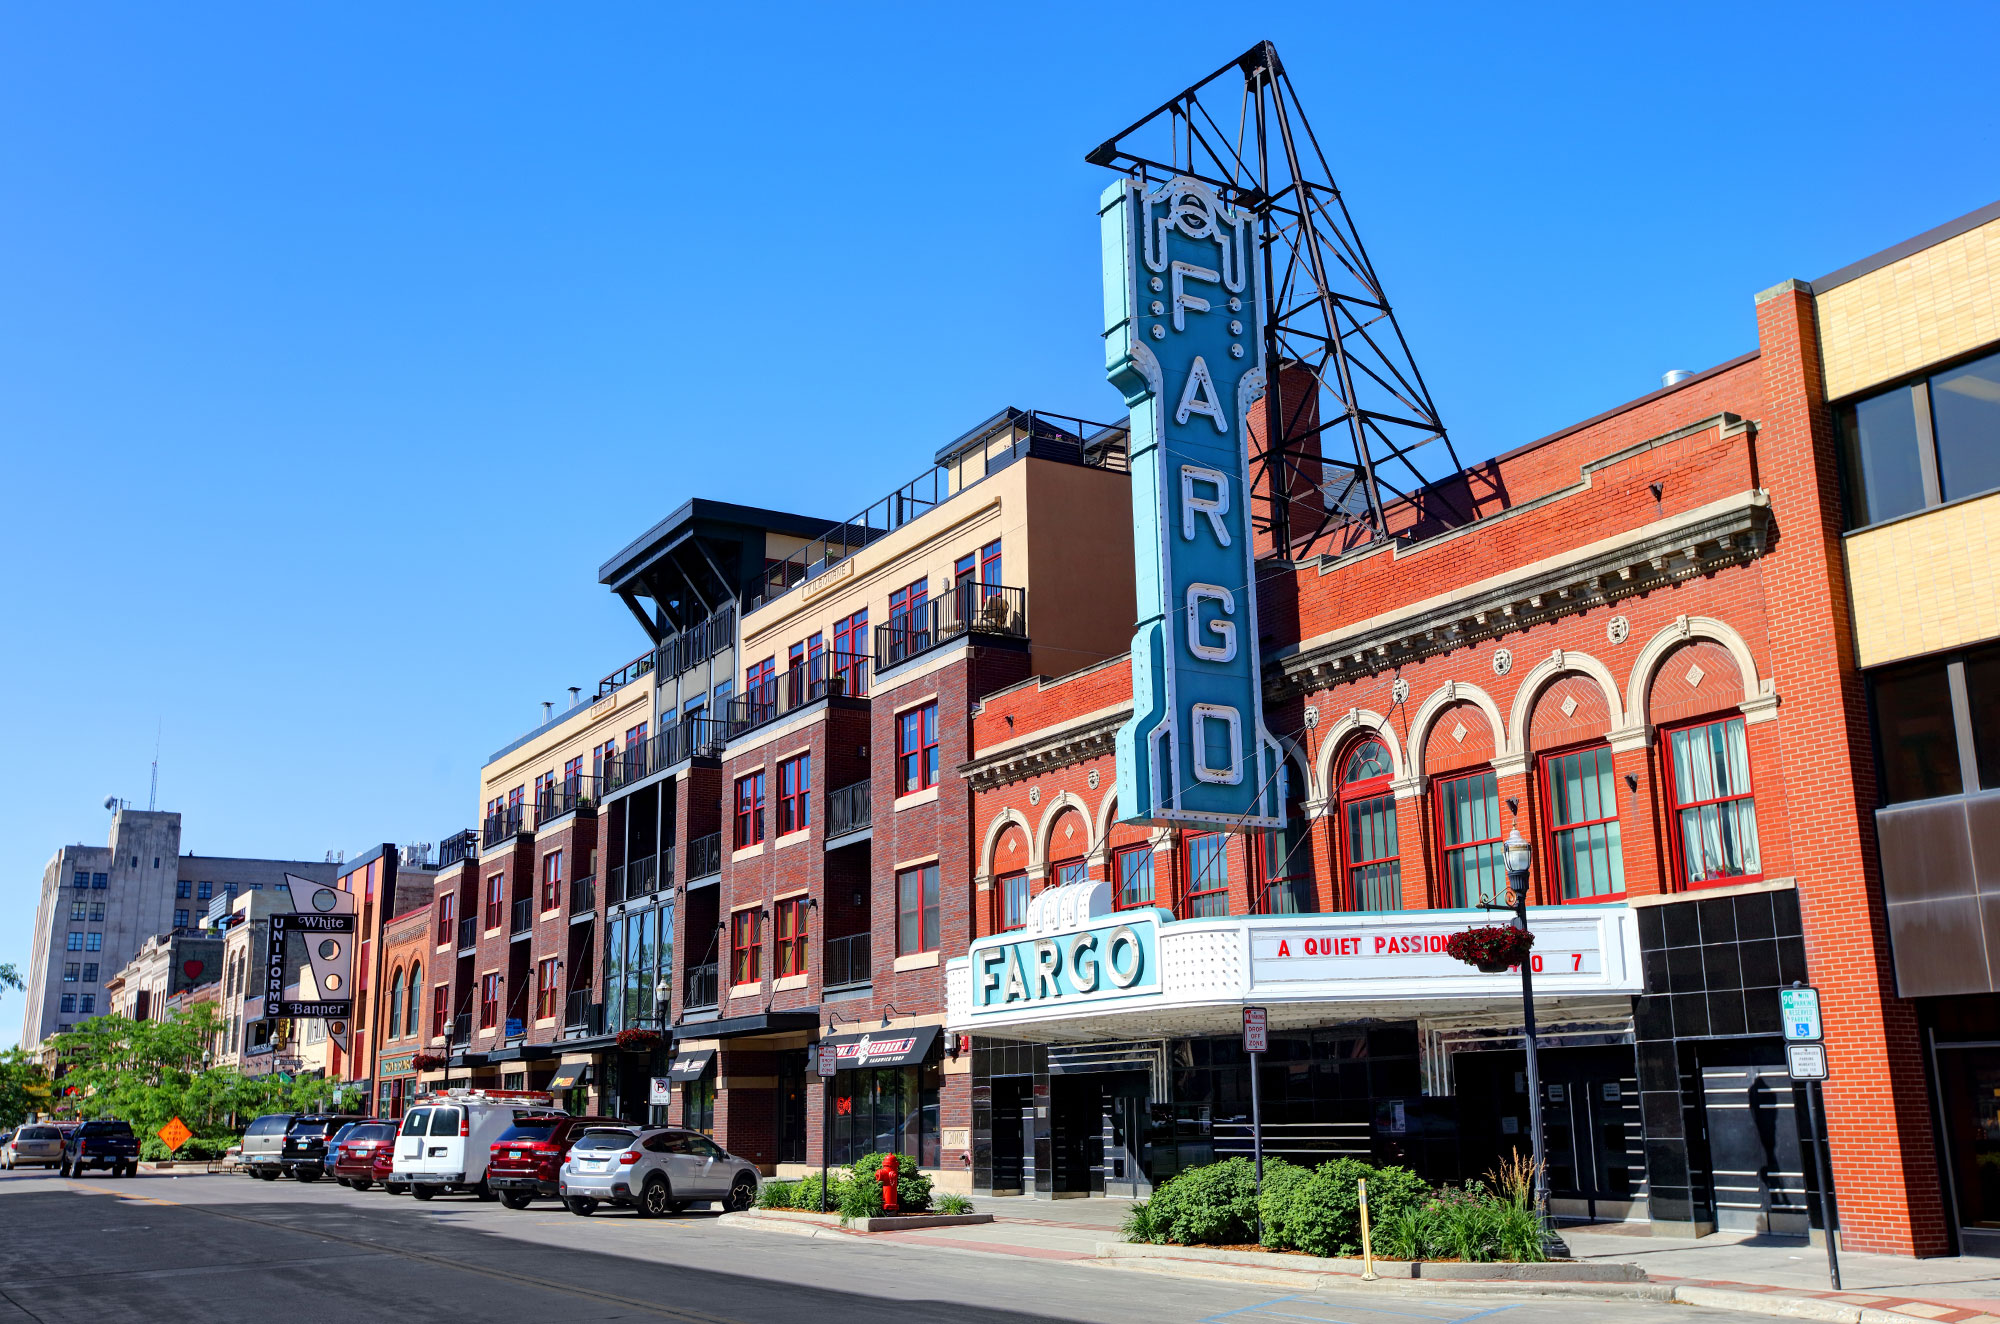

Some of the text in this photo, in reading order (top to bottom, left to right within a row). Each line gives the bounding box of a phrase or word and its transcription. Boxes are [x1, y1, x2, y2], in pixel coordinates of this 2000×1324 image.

[1170, 259, 1245, 786] FARGO
[298, 916, 344, 930] White
[1277, 934, 1452, 957] A QUIET PASSION
[268, 918, 285, 1014] UNIFORMS
[978, 925, 1145, 1007] FARGO
[1783, 994, 1794, 1005] 90
[288, 1003, 344, 1016] Banner
[947, 1131, 966, 1145] 2008
